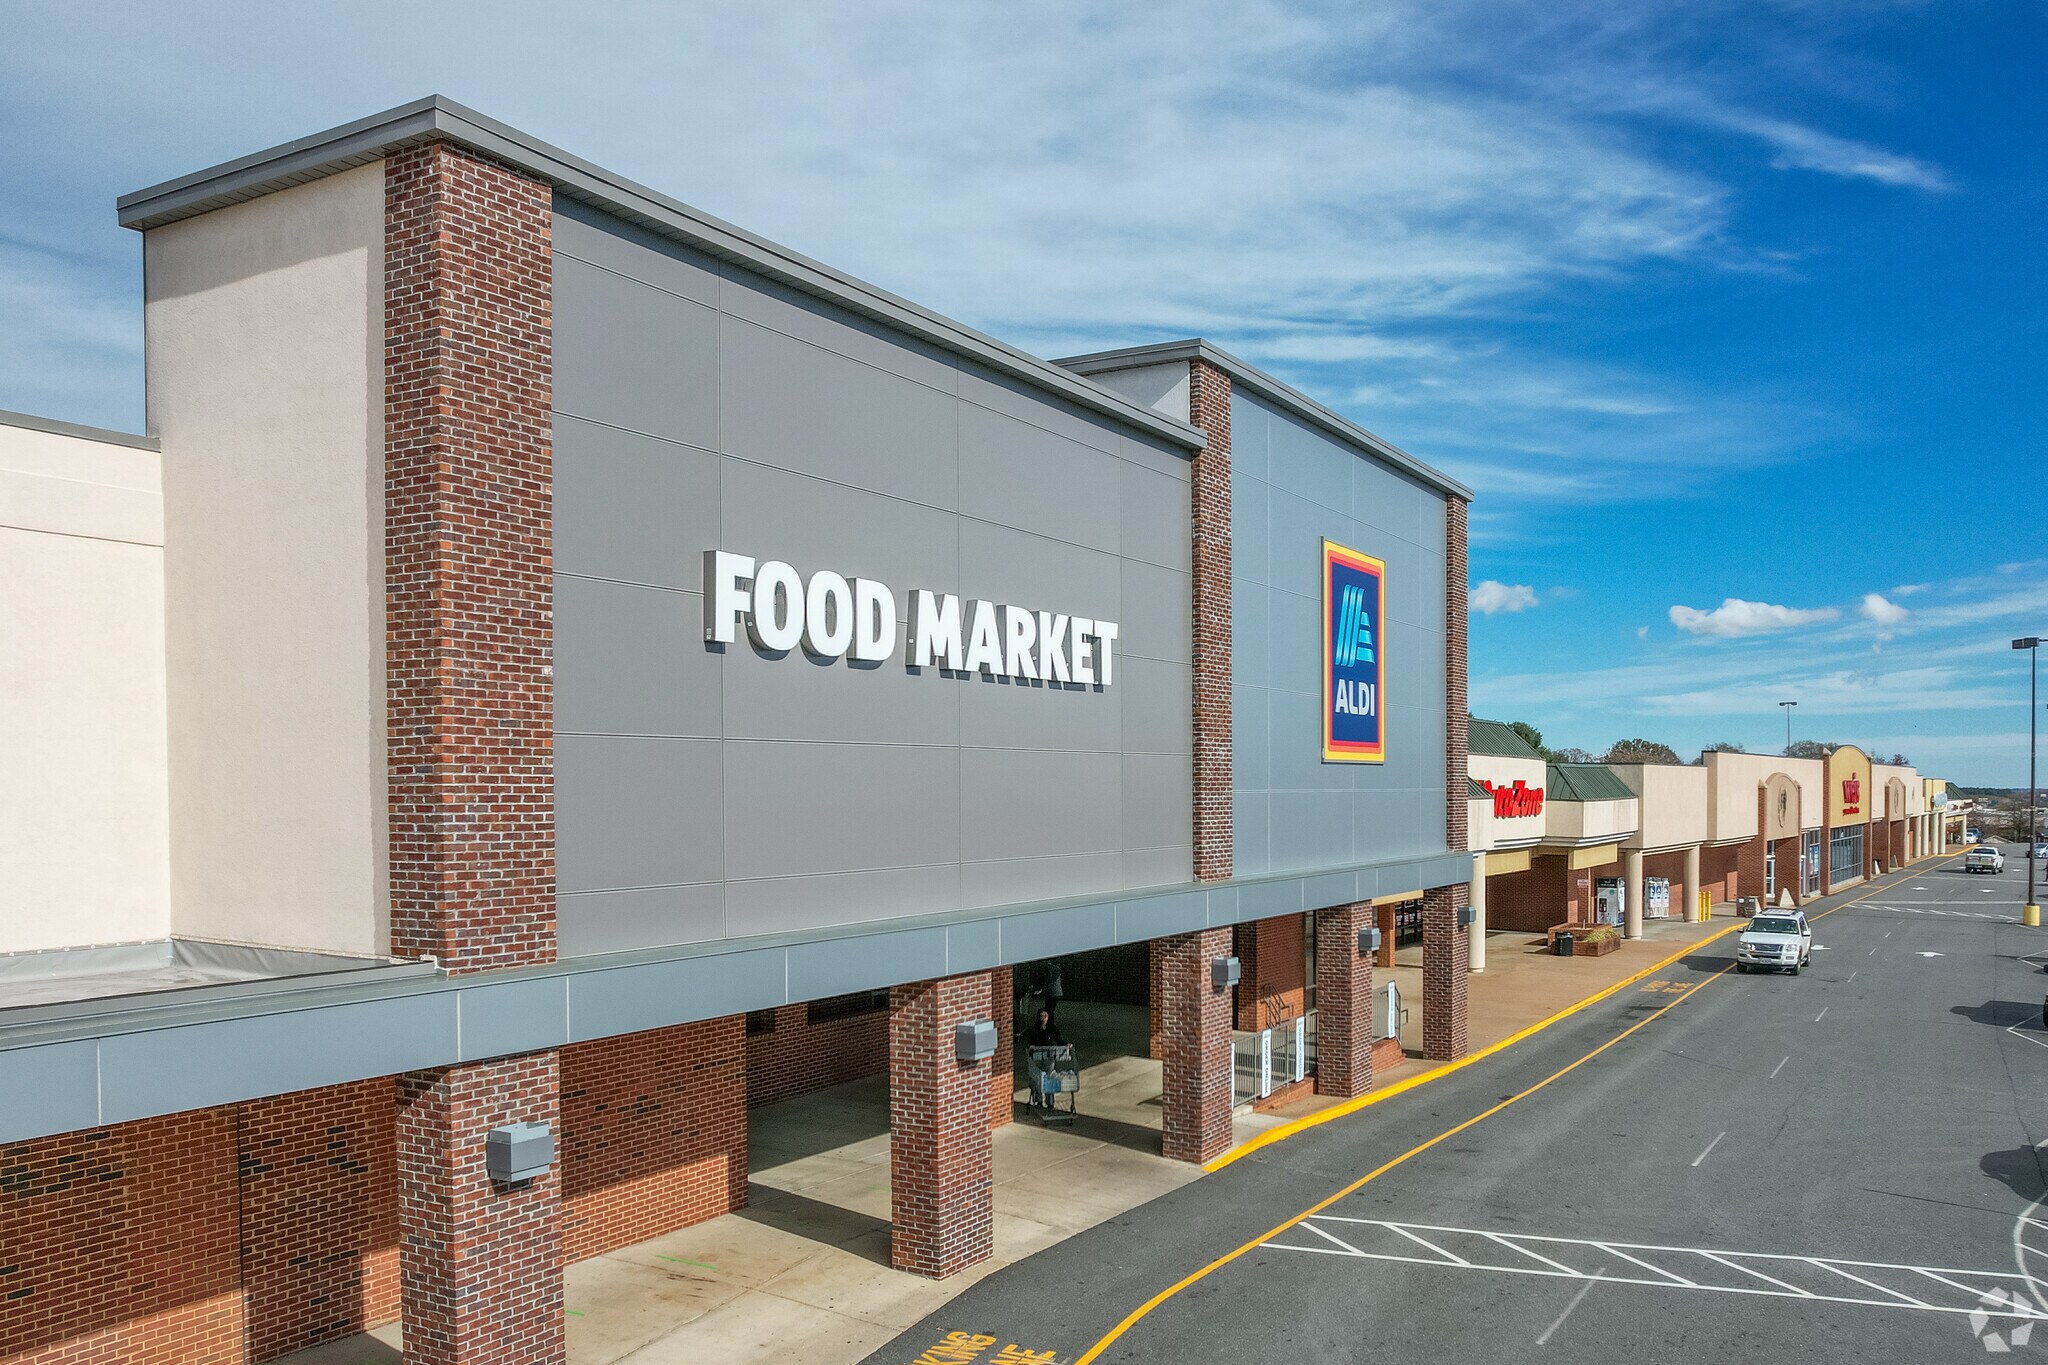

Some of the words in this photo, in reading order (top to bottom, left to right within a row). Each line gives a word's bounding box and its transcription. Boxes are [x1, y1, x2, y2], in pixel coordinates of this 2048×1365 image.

[705, 551, 897, 661] FOOD
[908, 590, 1118, 686] MARKET
[1335, 679, 1375, 717] ALDI
